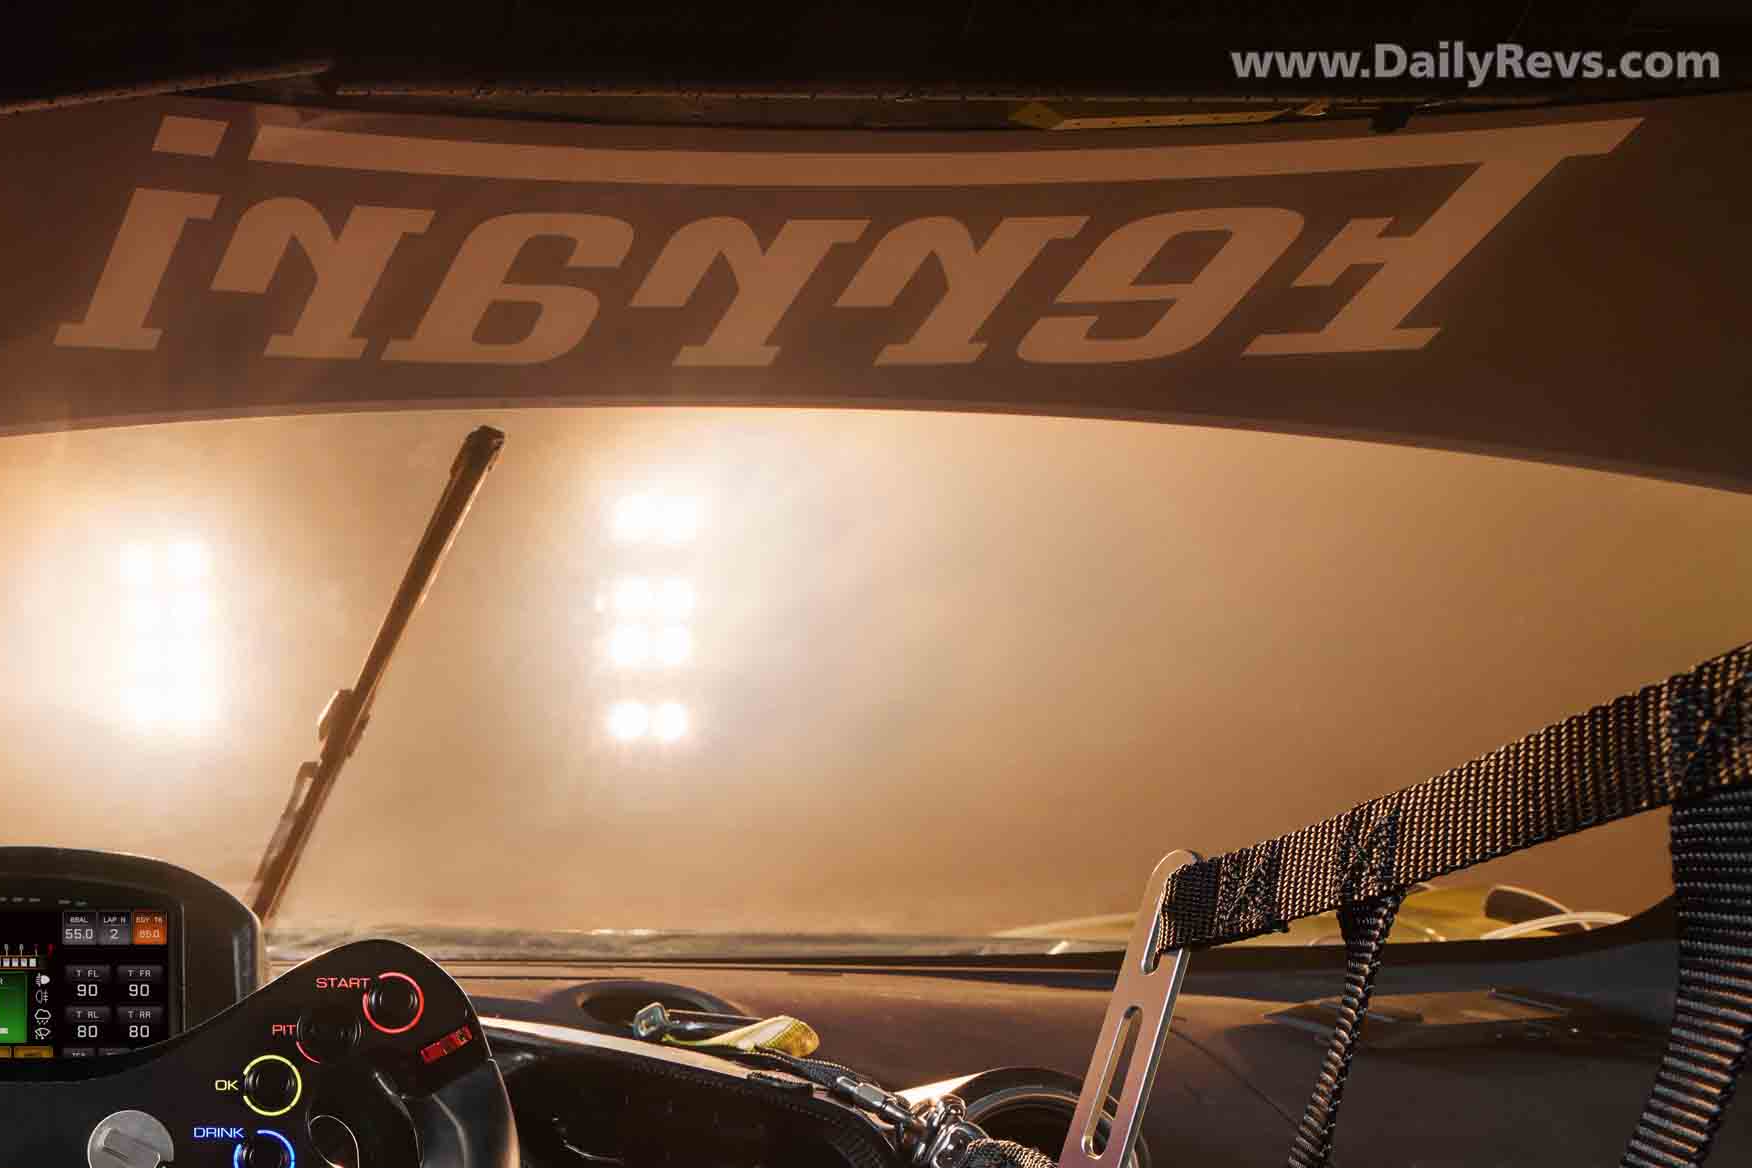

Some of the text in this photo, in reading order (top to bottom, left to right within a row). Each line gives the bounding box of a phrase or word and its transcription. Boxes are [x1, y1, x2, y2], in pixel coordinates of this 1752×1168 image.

[104, 916, 117, 924] LAP
[65, 928, 93, 939] 55.0
[110, 928, 119, 940] 2
[315, 977, 370, 989] START
[77, 984, 98, 996] 90
[128, 984, 150, 996] 90
[77, 1025, 98, 1038] 80
[128, 1025, 150, 1038] 80
[272, 1023, 297, 1035] PIT
[215, 1080, 238, 1091] OK
[193, 1127, 244, 1139] DRINK
